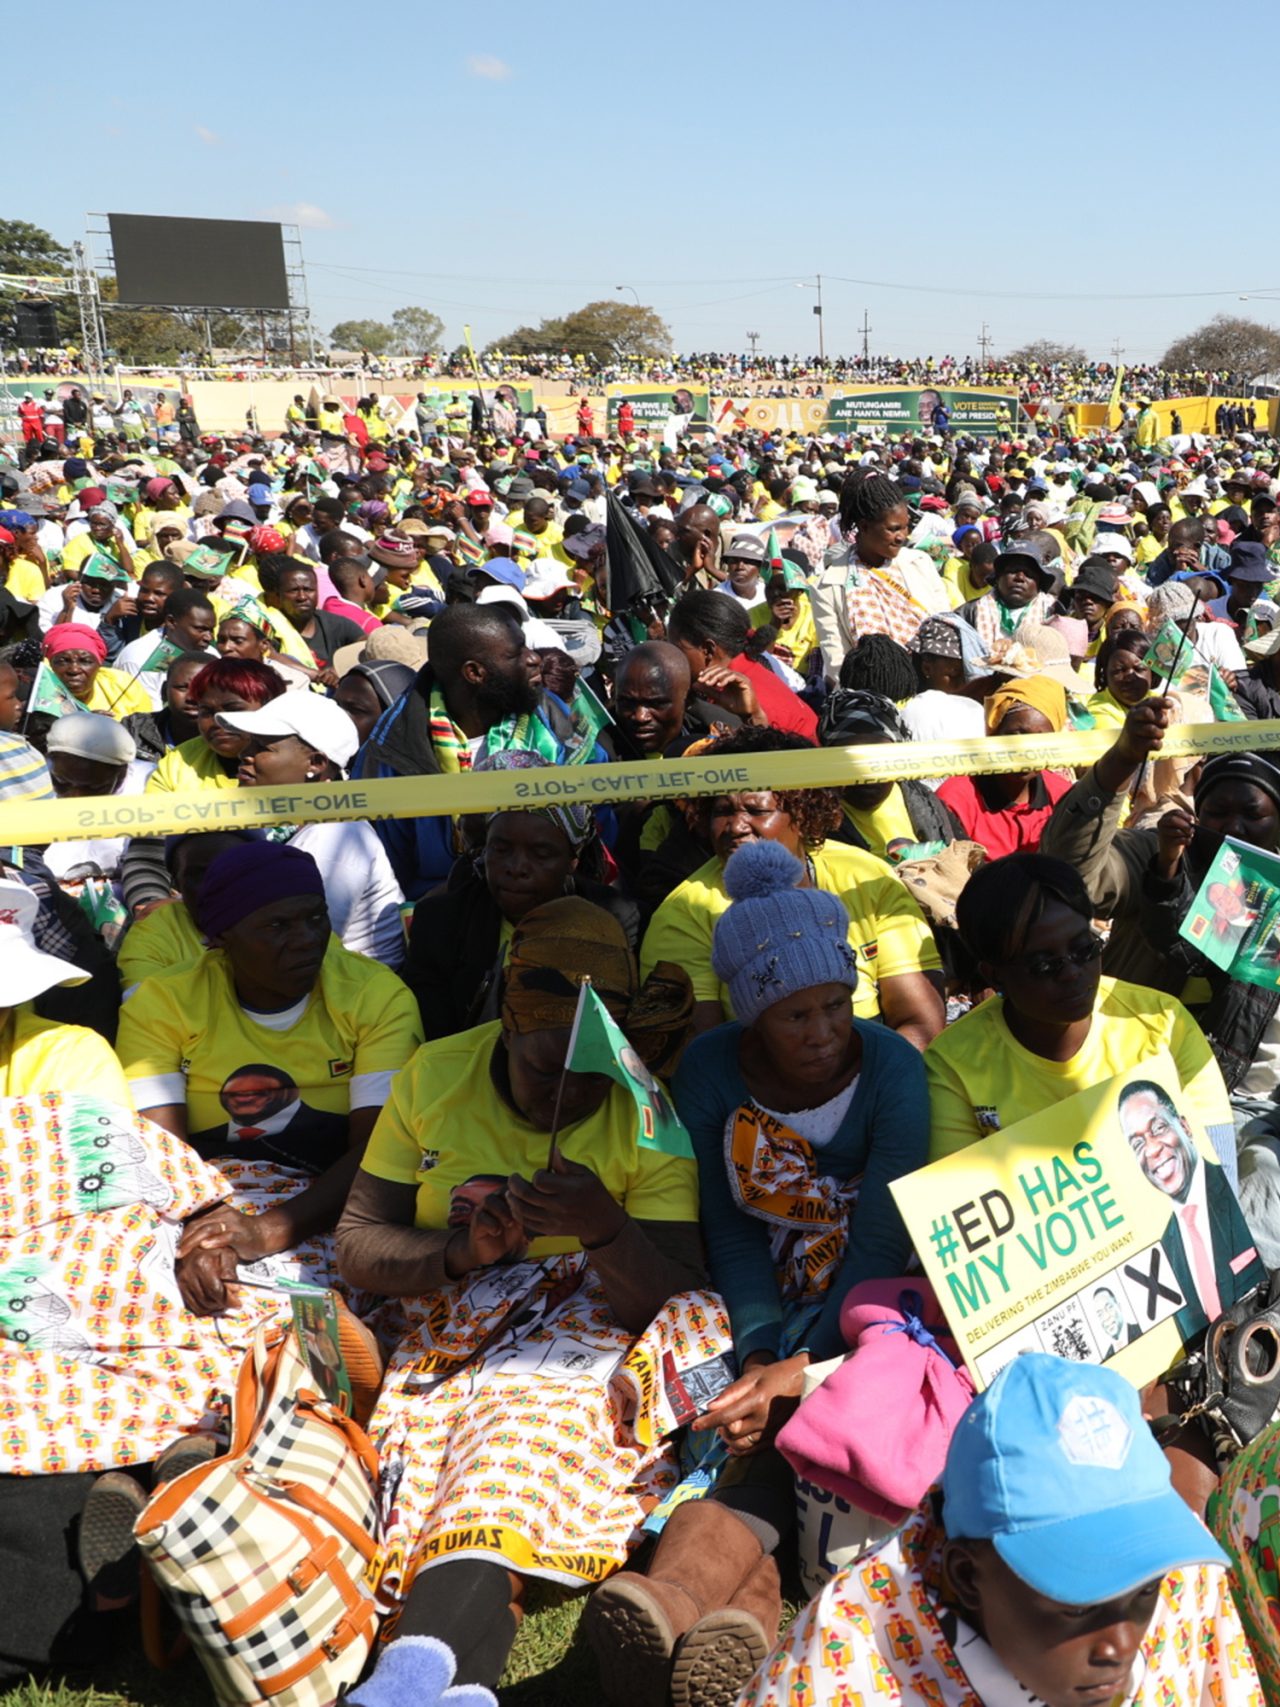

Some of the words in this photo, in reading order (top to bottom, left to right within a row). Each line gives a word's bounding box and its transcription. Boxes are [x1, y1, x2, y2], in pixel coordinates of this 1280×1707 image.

[835, 410, 852, 418] ANE
[854, 410, 881, 418] HANYA
[952, 412, 967, 420] FOR
[953, 402, 978, 411] VOTE
[929, 1188, 1016, 1269] #ED
[1018, 1141, 1104, 1217] HAS
[946, 1244, 1011, 1320] MY
[1016, 1183, 1126, 1271] VOTE
[966, 1301, 1025, 1344] DELIVERING
[1025, 1289, 1046, 1307] THE
[1045, 1259, 1092, 1296] ZIMBABWE
[1091, 1248, 1111, 1265] YOU
[1110, 1231, 1136, 1253] WANT
[1040, 1310, 1067, 1331] ZANU
[1066, 1302, 1079, 1315] PF
[623, 1351, 653, 1397] ZANU
